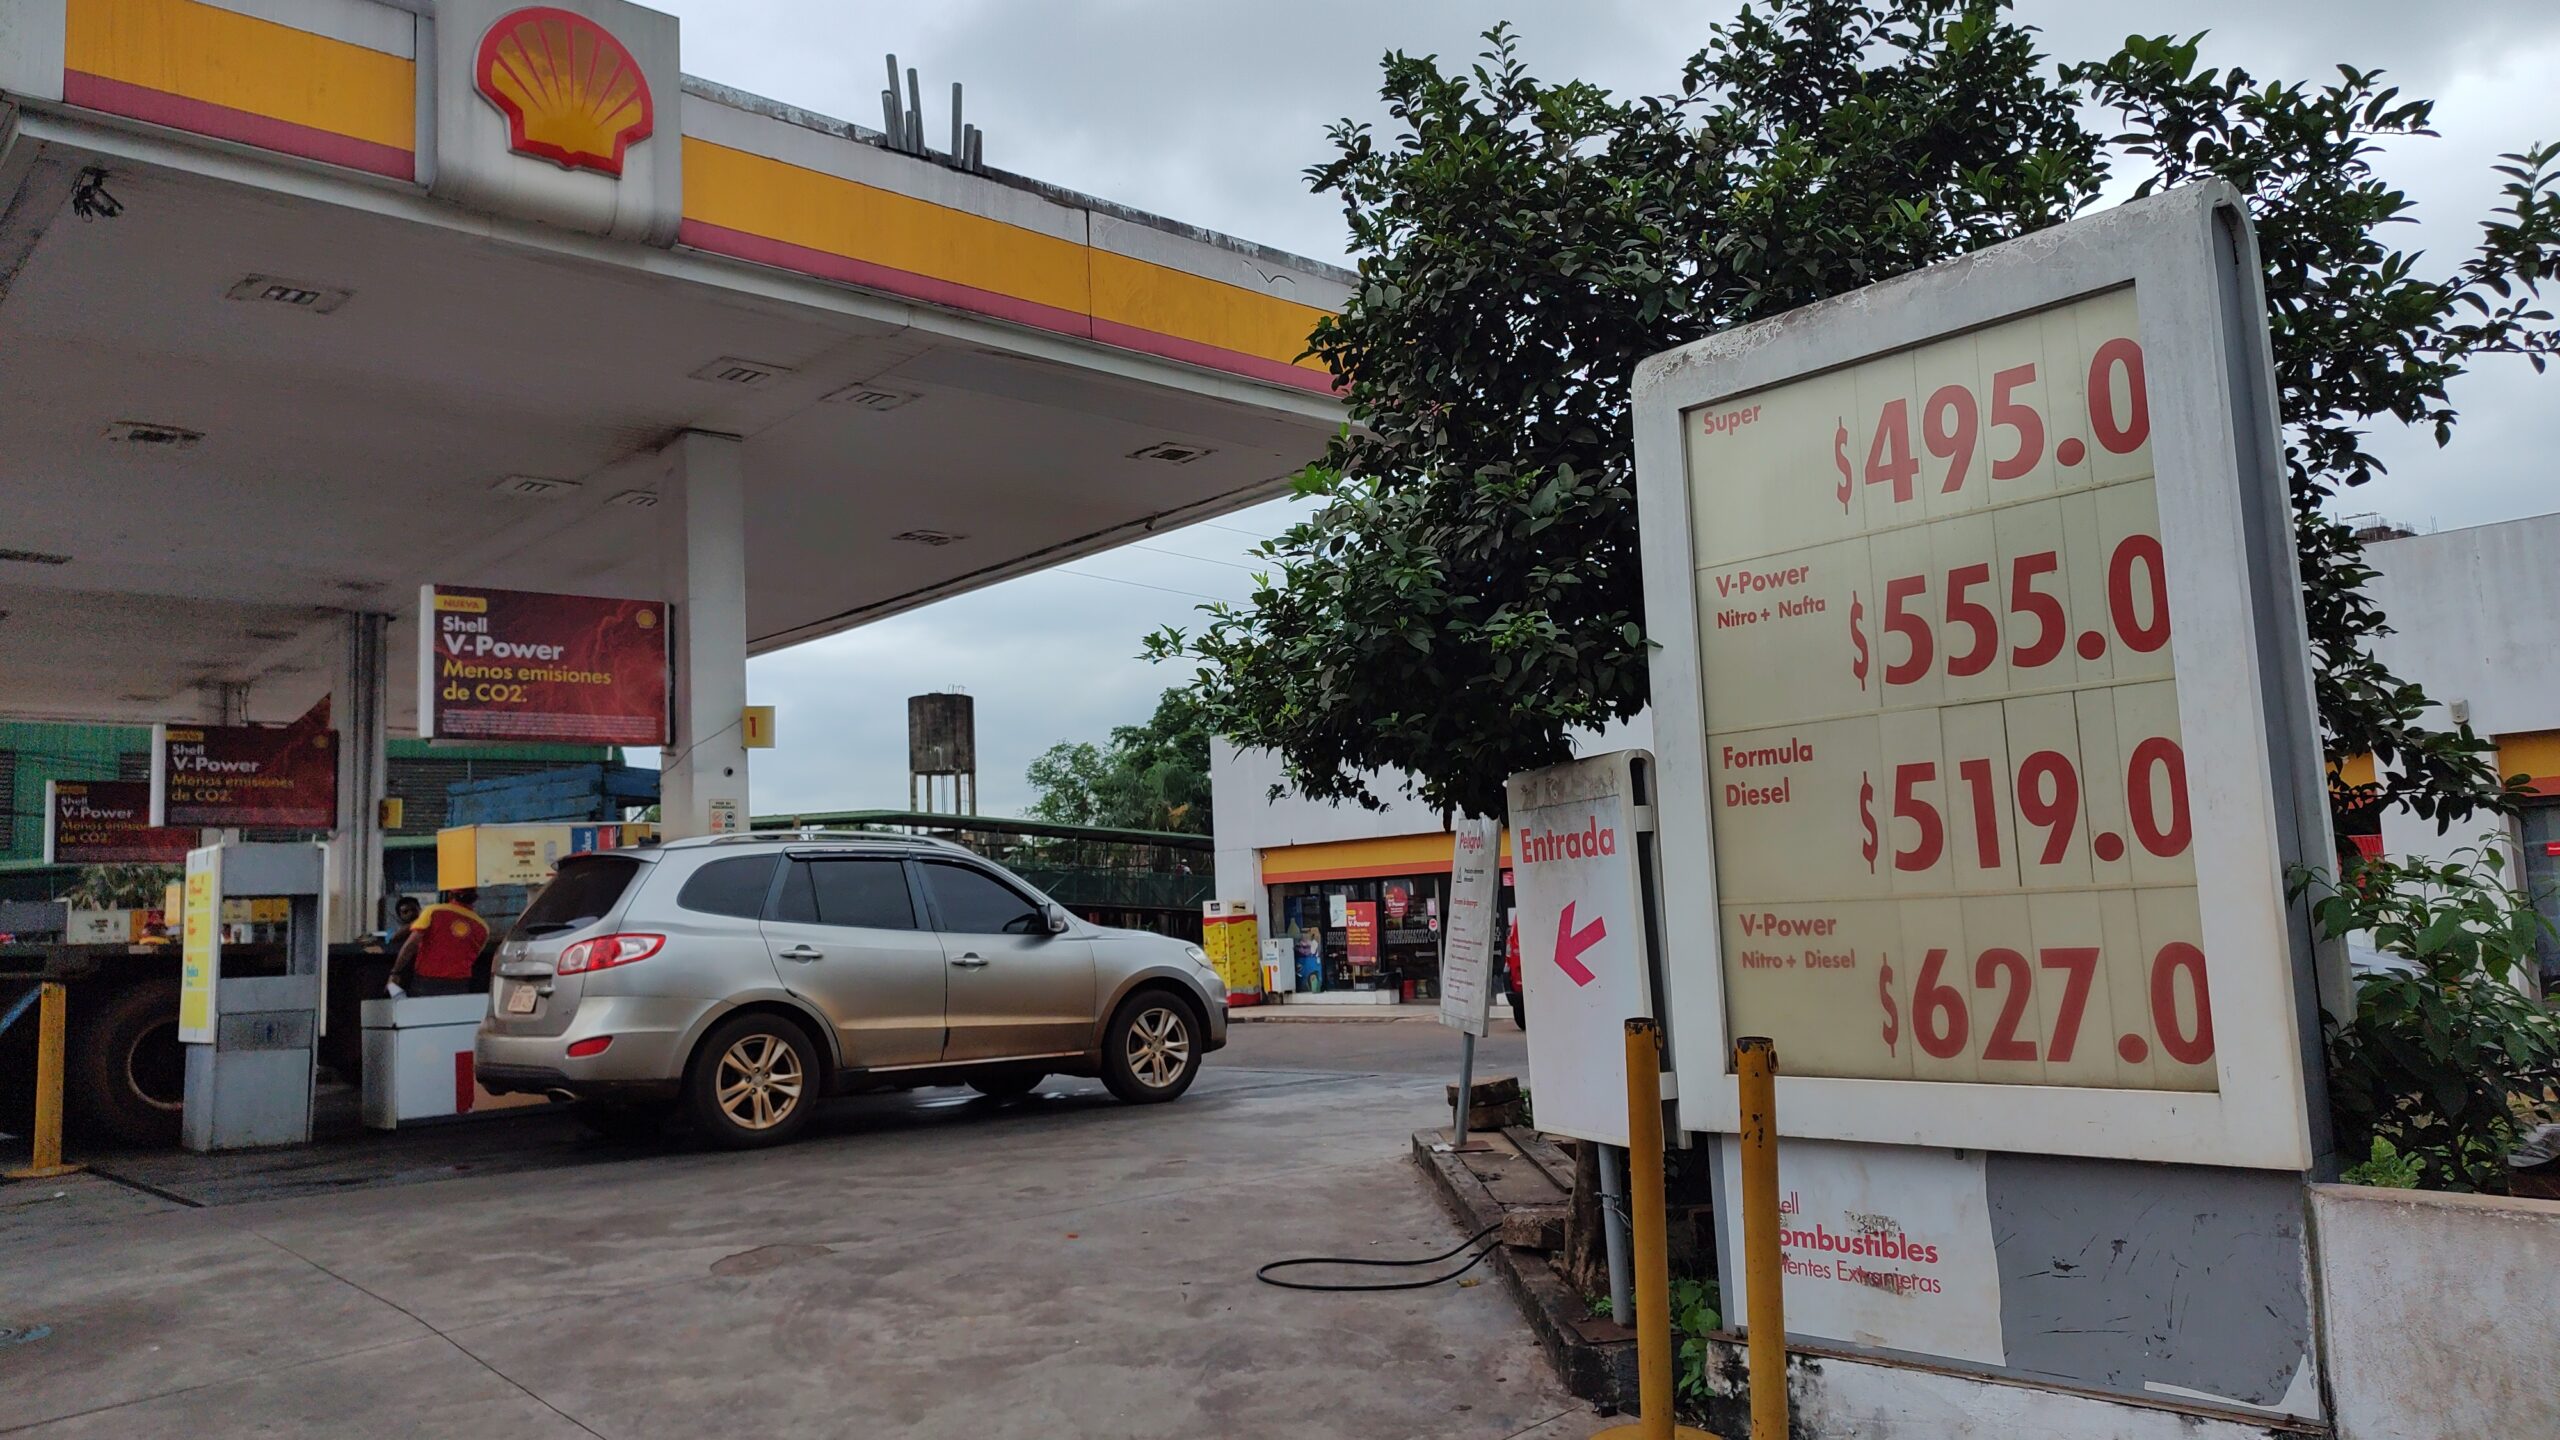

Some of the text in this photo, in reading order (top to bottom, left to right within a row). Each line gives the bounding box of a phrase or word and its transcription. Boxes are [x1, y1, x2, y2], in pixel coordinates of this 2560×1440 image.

[1703, 402, 1761, 435] Super
[1716, 563, 1809, 598] V-Power
[1778, 594, 1826, 621] Nafta
[442, 615, 488, 633] Shell
[443, 634, 565, 661] V-Power
[443, 659, 612, 685] Menos emisiones
[443, 681, 470, 701] de
[749, 716, 757, 738] 1
[172, 743, 205, 756] Shell
[1722, 737, 1814, 770] Formula
[173, 756, 260, 773] V-Power
[171, 773, 222, 786] Menos
[171, 788, 190, 801] de
[1725, 777, 1791, 808] Diesel
[61, 806, 134, 820] V-Power
[1519, 815, 1616, 864] Entrada
[1739, 913, 1837, 938] V-Power
[1804, 949, 1856, 970] Diesel
[1781, 1191, 1800, 1215] ell
[1779, 1223, 1939, 1264] ombustibles
